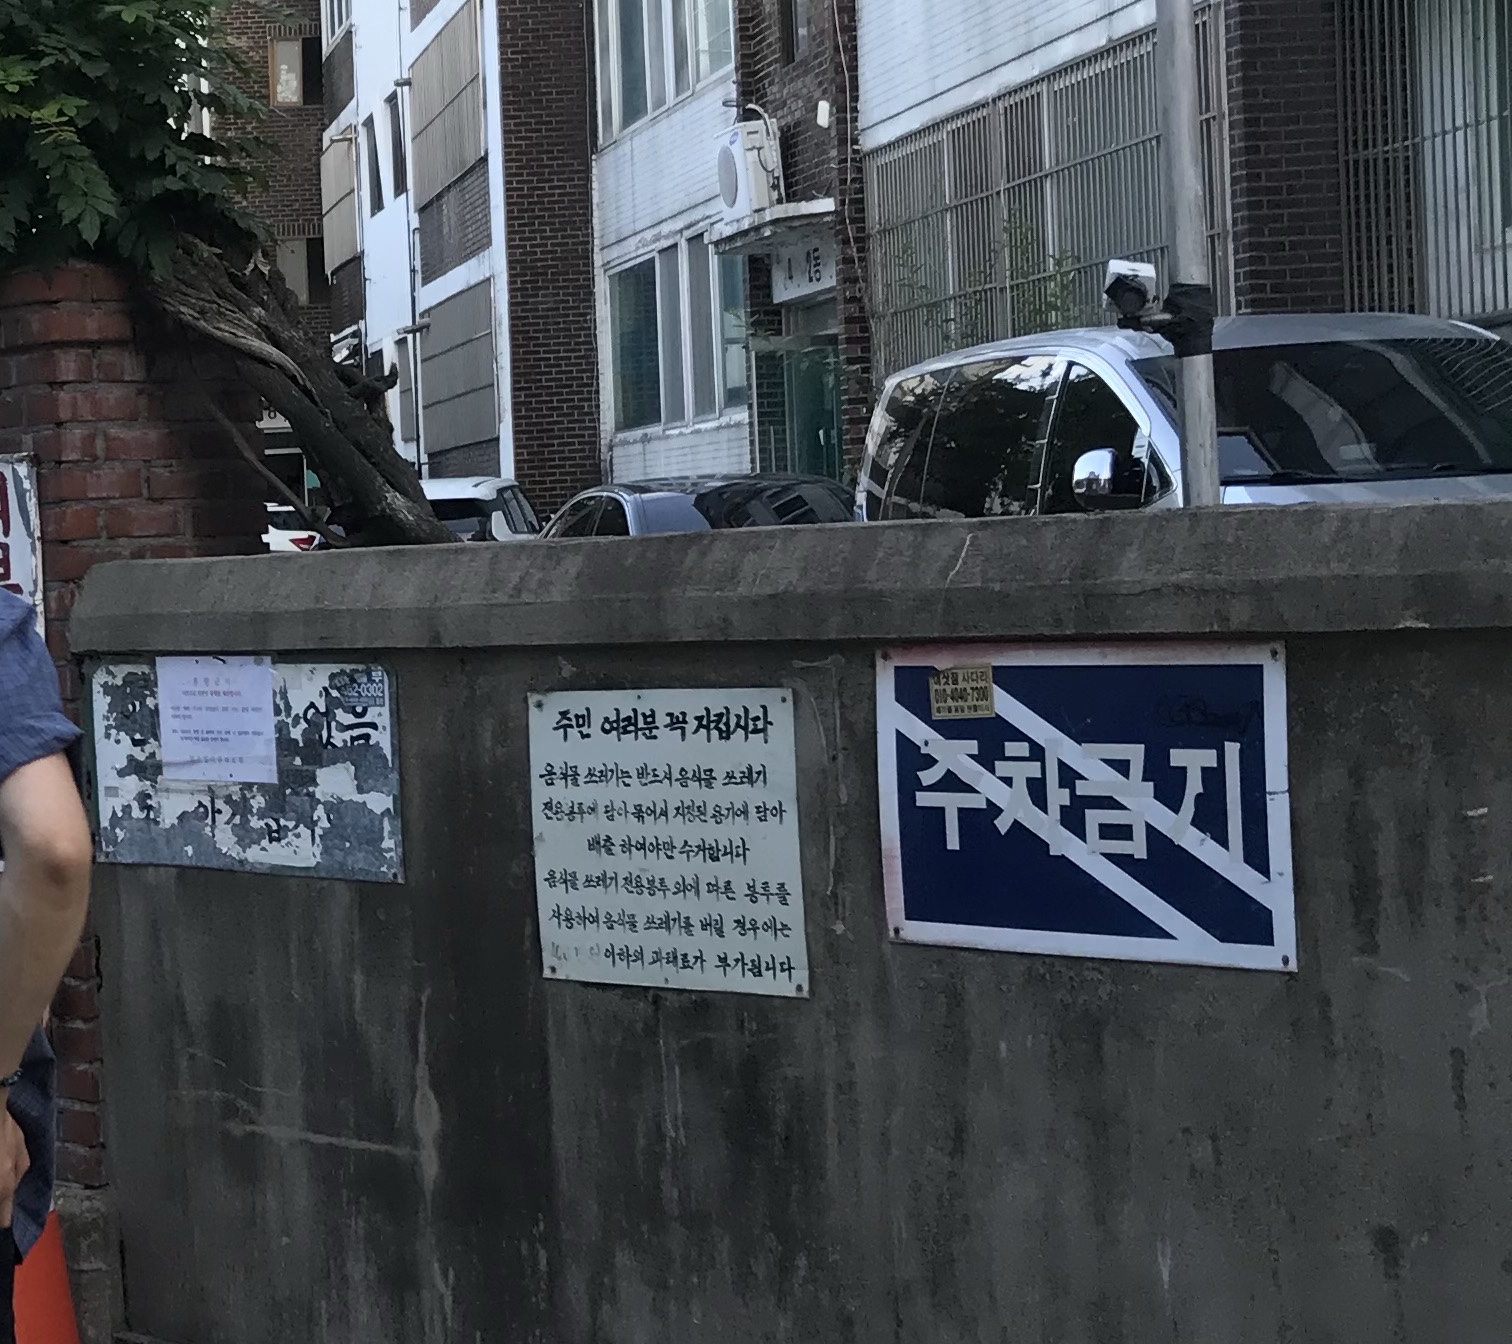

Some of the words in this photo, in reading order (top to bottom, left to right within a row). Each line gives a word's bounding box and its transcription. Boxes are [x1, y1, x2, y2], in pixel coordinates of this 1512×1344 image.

[552, 706, 592, 742] 주민
[600, 707, 661, 742] 여러분
[663, 710, 689, 743] 꼭
[539, 760, 581, 789] 음식물
[583, 761, 633, 788] 쓰레기는
[635, 761, 673, 789] 반드시
[674, 762, 718, 790] 음식물
[721, 762, 768, 789] 쓰레기
[603, 799, 630, 824] 담아
[672, 799, 708, 825] 지정된
[710, 800, 750, 826] 용기에
[754, 799, 788, 825] 담아
[914, 737, 1245, 864] 주차금지
[586, 832, 616, 859] 배출
[619, 834, 677, 861] 하여야만
[678, 836, 751, 866] 수거합니다
[543, 868, 579, 894] 음식물
[582, 869, 619, 895] 쓰레기
[621, 870, 671, 900] 전용봉투
[743, 877, 792, 907] 봉투를
[548, 902, 600, 933] 사용하여
[602, 907, 639, 934] 음식물
[643, 909, 695, 937] 쓰레기를
[699, 912, 726, 939] 버릴
[732, 914, 793, 942] 경우에는
[648, 946, 707, 975] 과태료가
[714, 950, 797, 984] 부가됩니다
